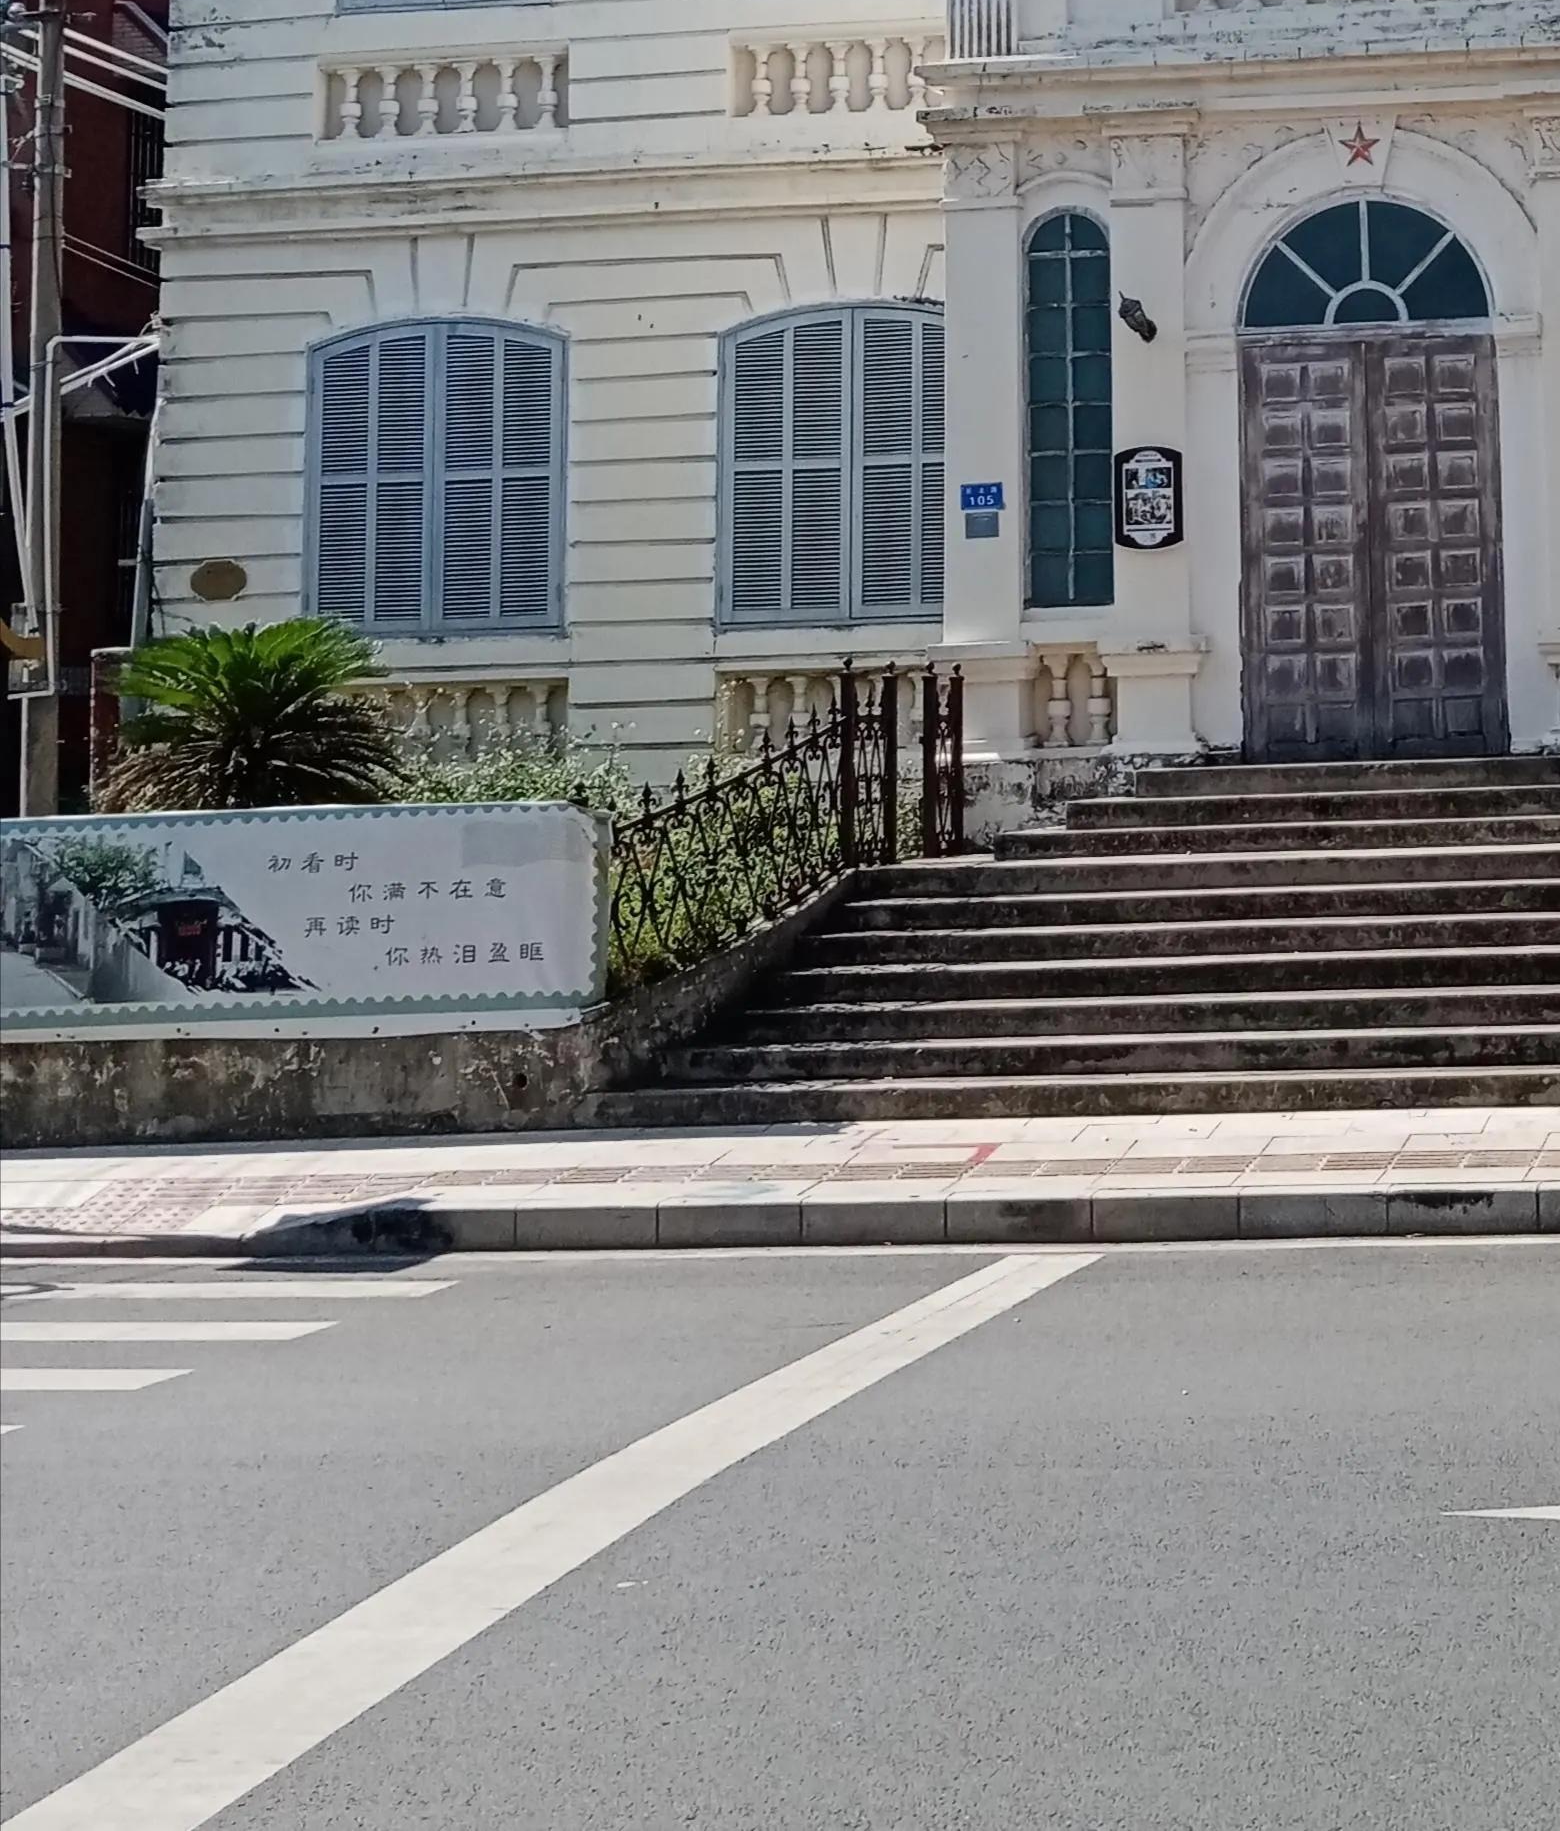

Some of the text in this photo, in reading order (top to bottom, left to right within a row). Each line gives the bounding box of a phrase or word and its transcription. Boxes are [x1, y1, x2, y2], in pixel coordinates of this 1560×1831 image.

[968, 494, 995, 507] 105
[266, 850, 359, 874] 初看时
[347, 877, 508, 903] 你满不在意
[303, 913, 396, 939] 再读时
[384, 941, 545, 967] 你热泪盈眶
